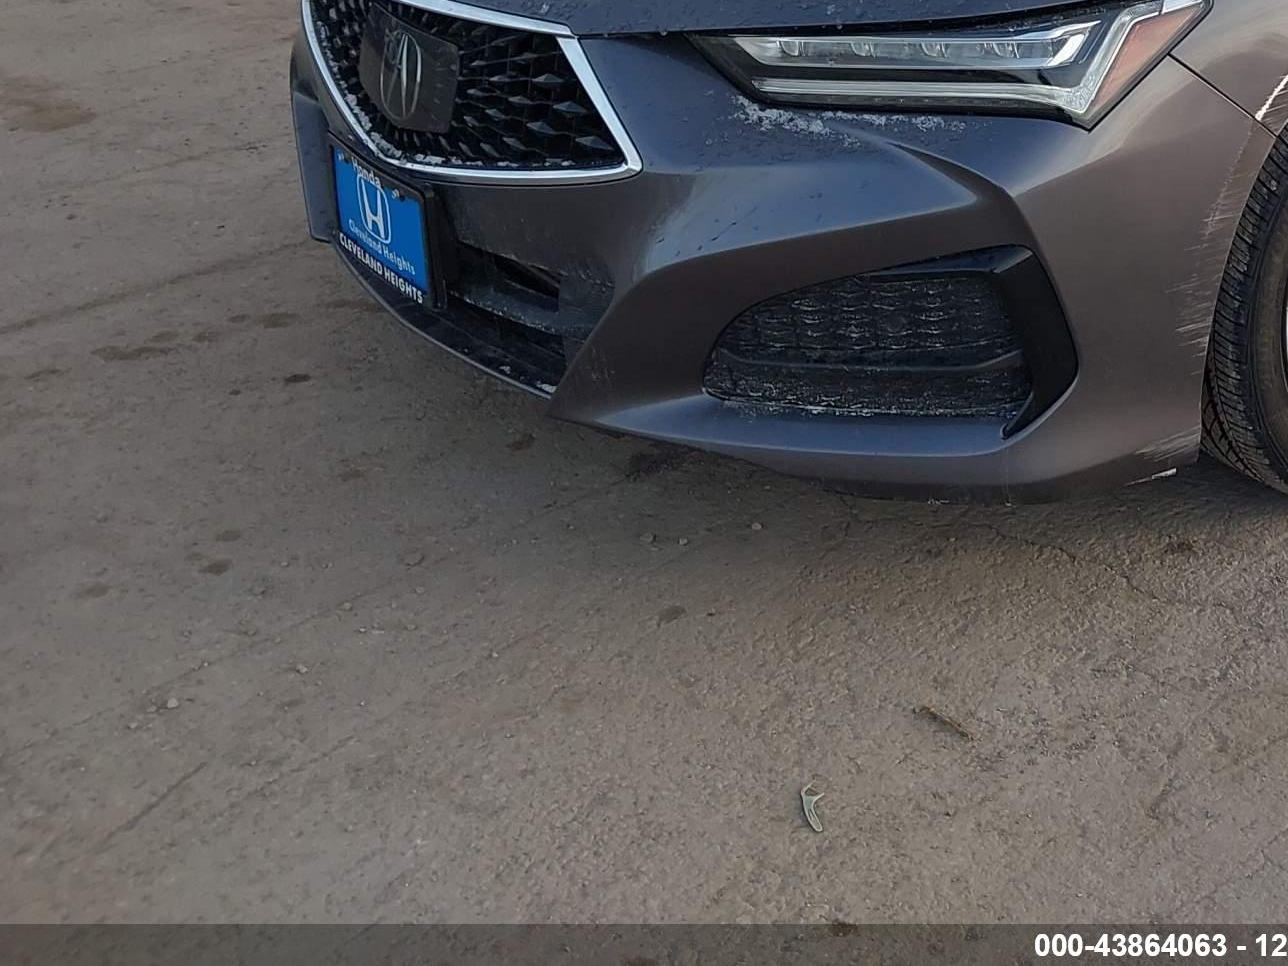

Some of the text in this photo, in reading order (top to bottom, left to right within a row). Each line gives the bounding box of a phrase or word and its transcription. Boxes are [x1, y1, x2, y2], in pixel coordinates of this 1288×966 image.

[351, 156, 381, 188] Honda
[339, 232, 423, 304] CLEVELAND HEIGHTS
[383, 246, 416, 275] Heights
